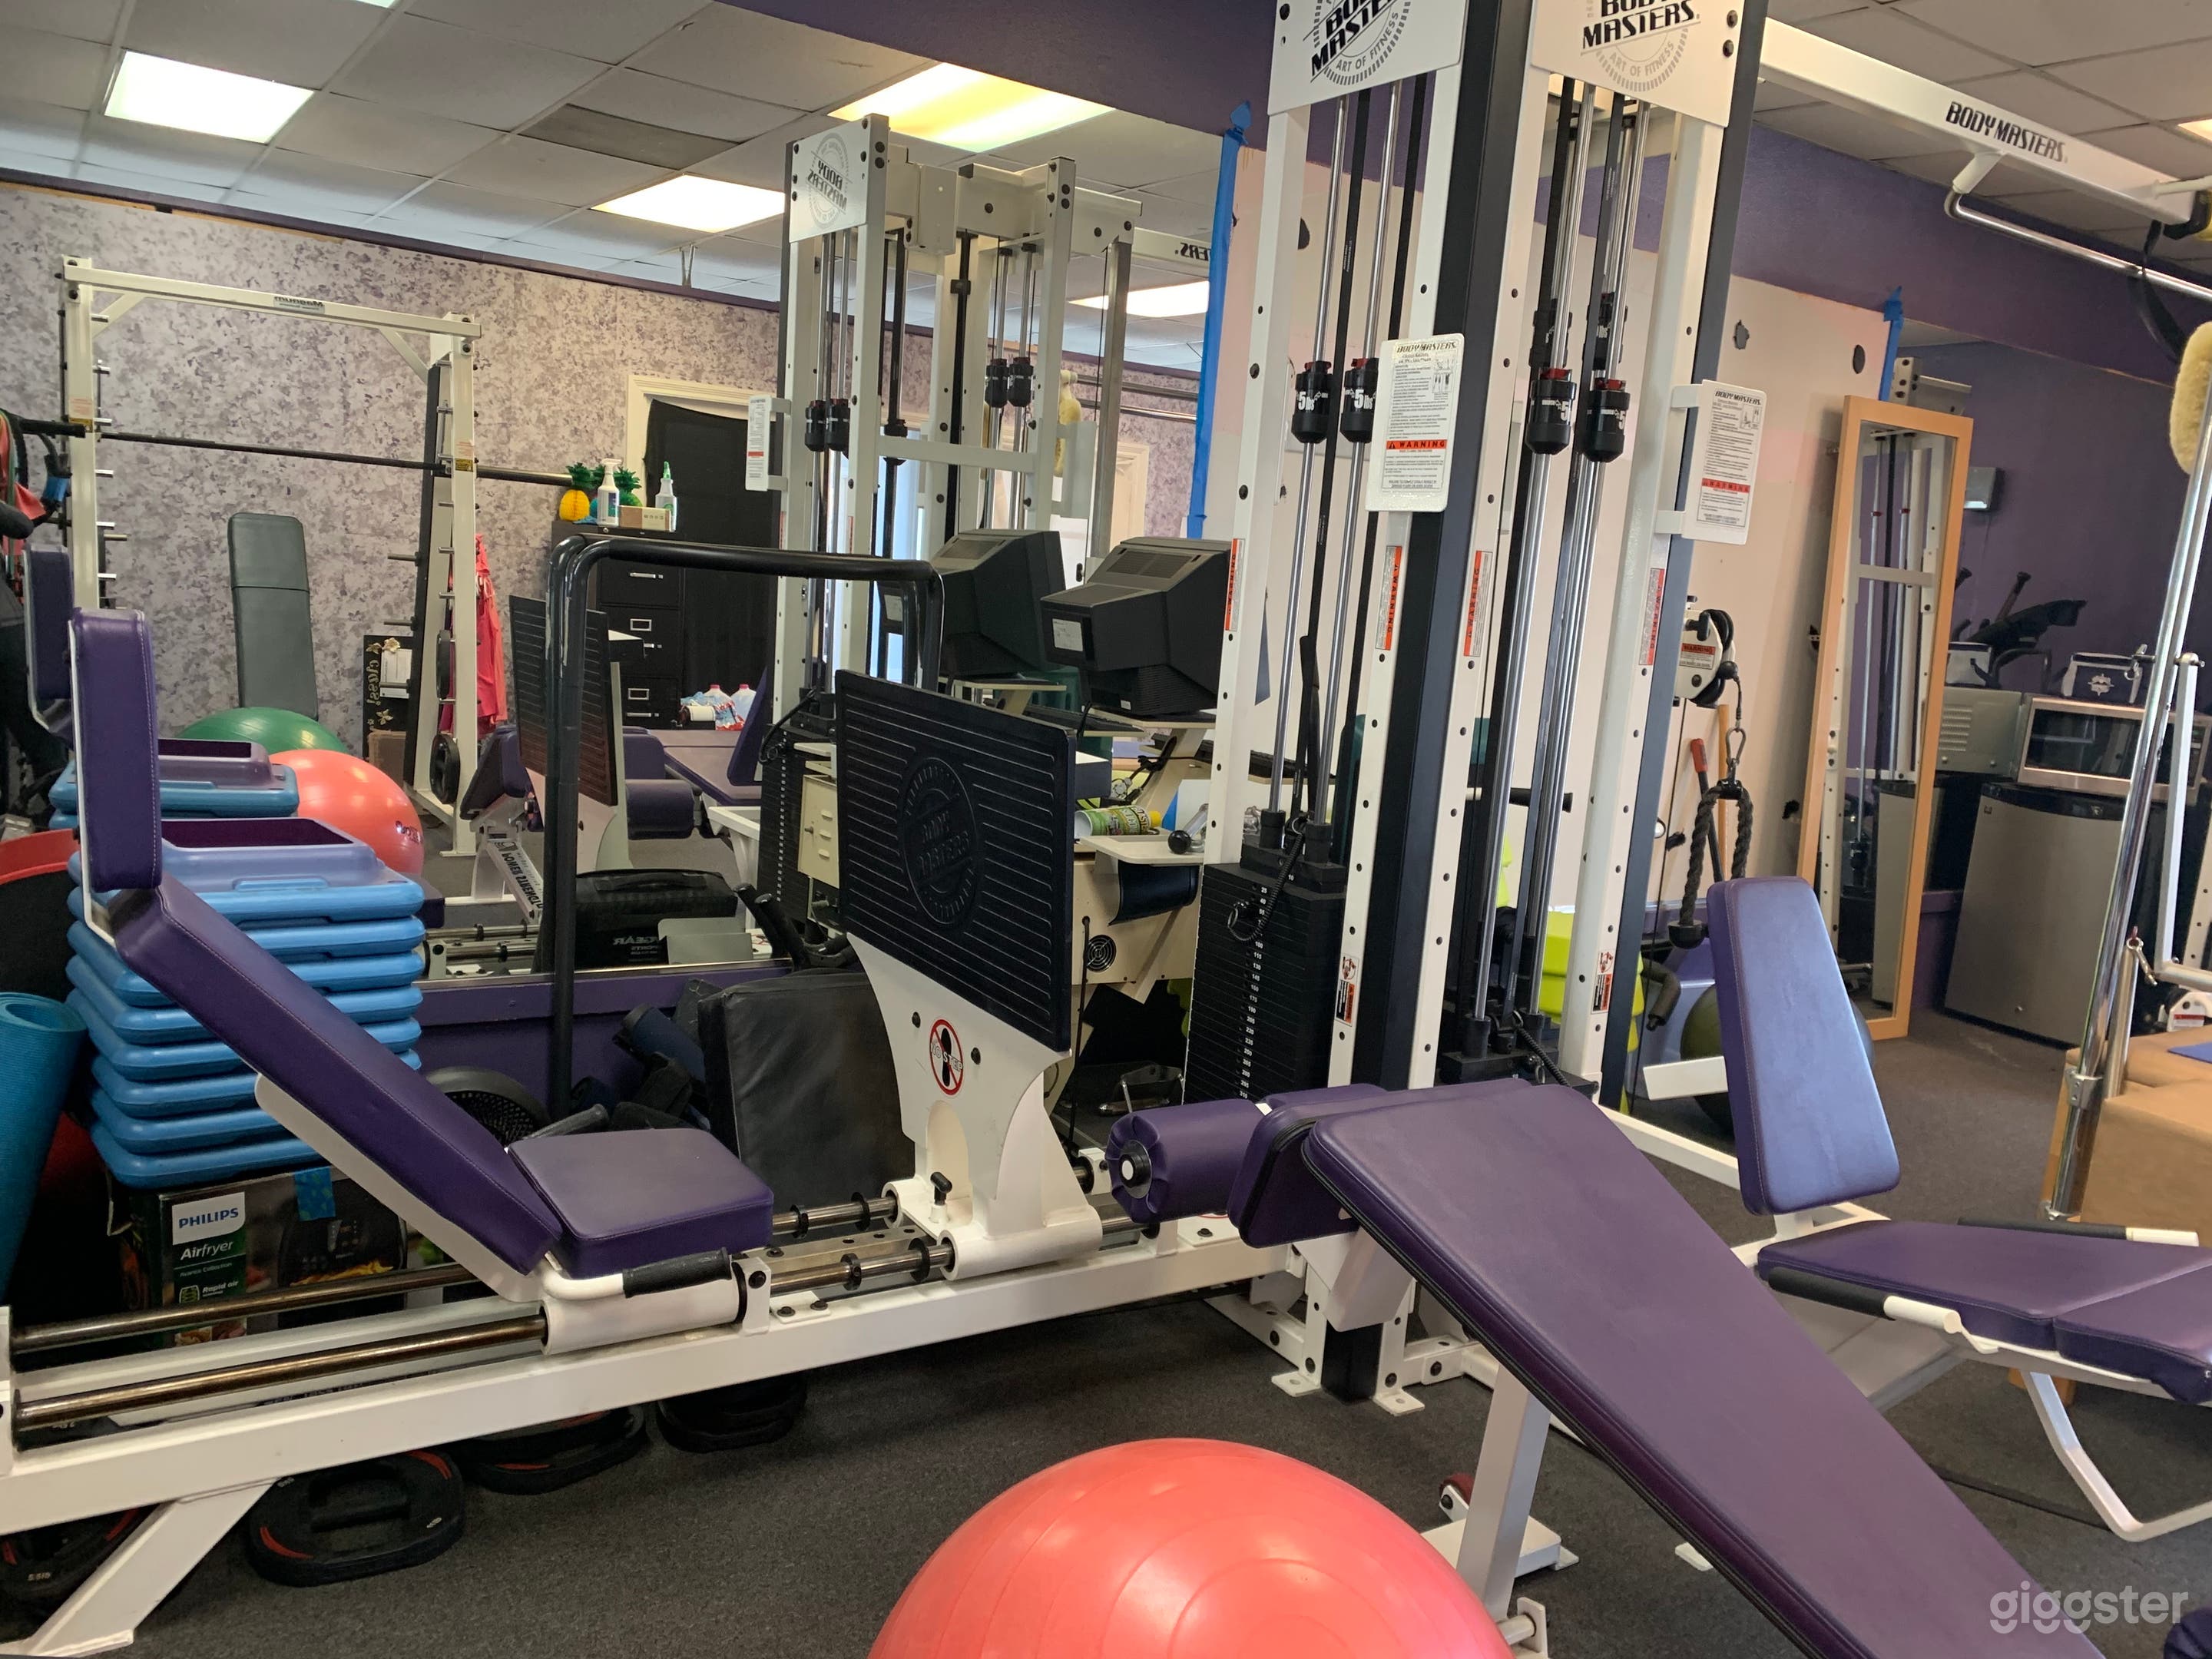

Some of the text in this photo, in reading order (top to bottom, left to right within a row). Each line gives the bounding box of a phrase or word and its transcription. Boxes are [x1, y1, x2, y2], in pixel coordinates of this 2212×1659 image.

[1312, 0, 1392, 76] MASTE
[1336, 12, 1399, 72] ART OF FITNESS
[1583, 0, 1694, 49] MASTERS
[1610, 41, 1674, 77] ART OF FITNESS
[1945, 101, 2065, 162] BODY MASTERS
[1400, 440, 1445, 449] WARNING
[1387, 576, 1399, 633] WARNING
[1468, 568, 1480, 627] WARNING
[931, 1039, 963, 1071] NO STEP
[179, 1207, 239, 1229] PHILIPS
[180, 1241, 233, 1260] Airfryer
[202, 1283, 226, 1293] Rapid
